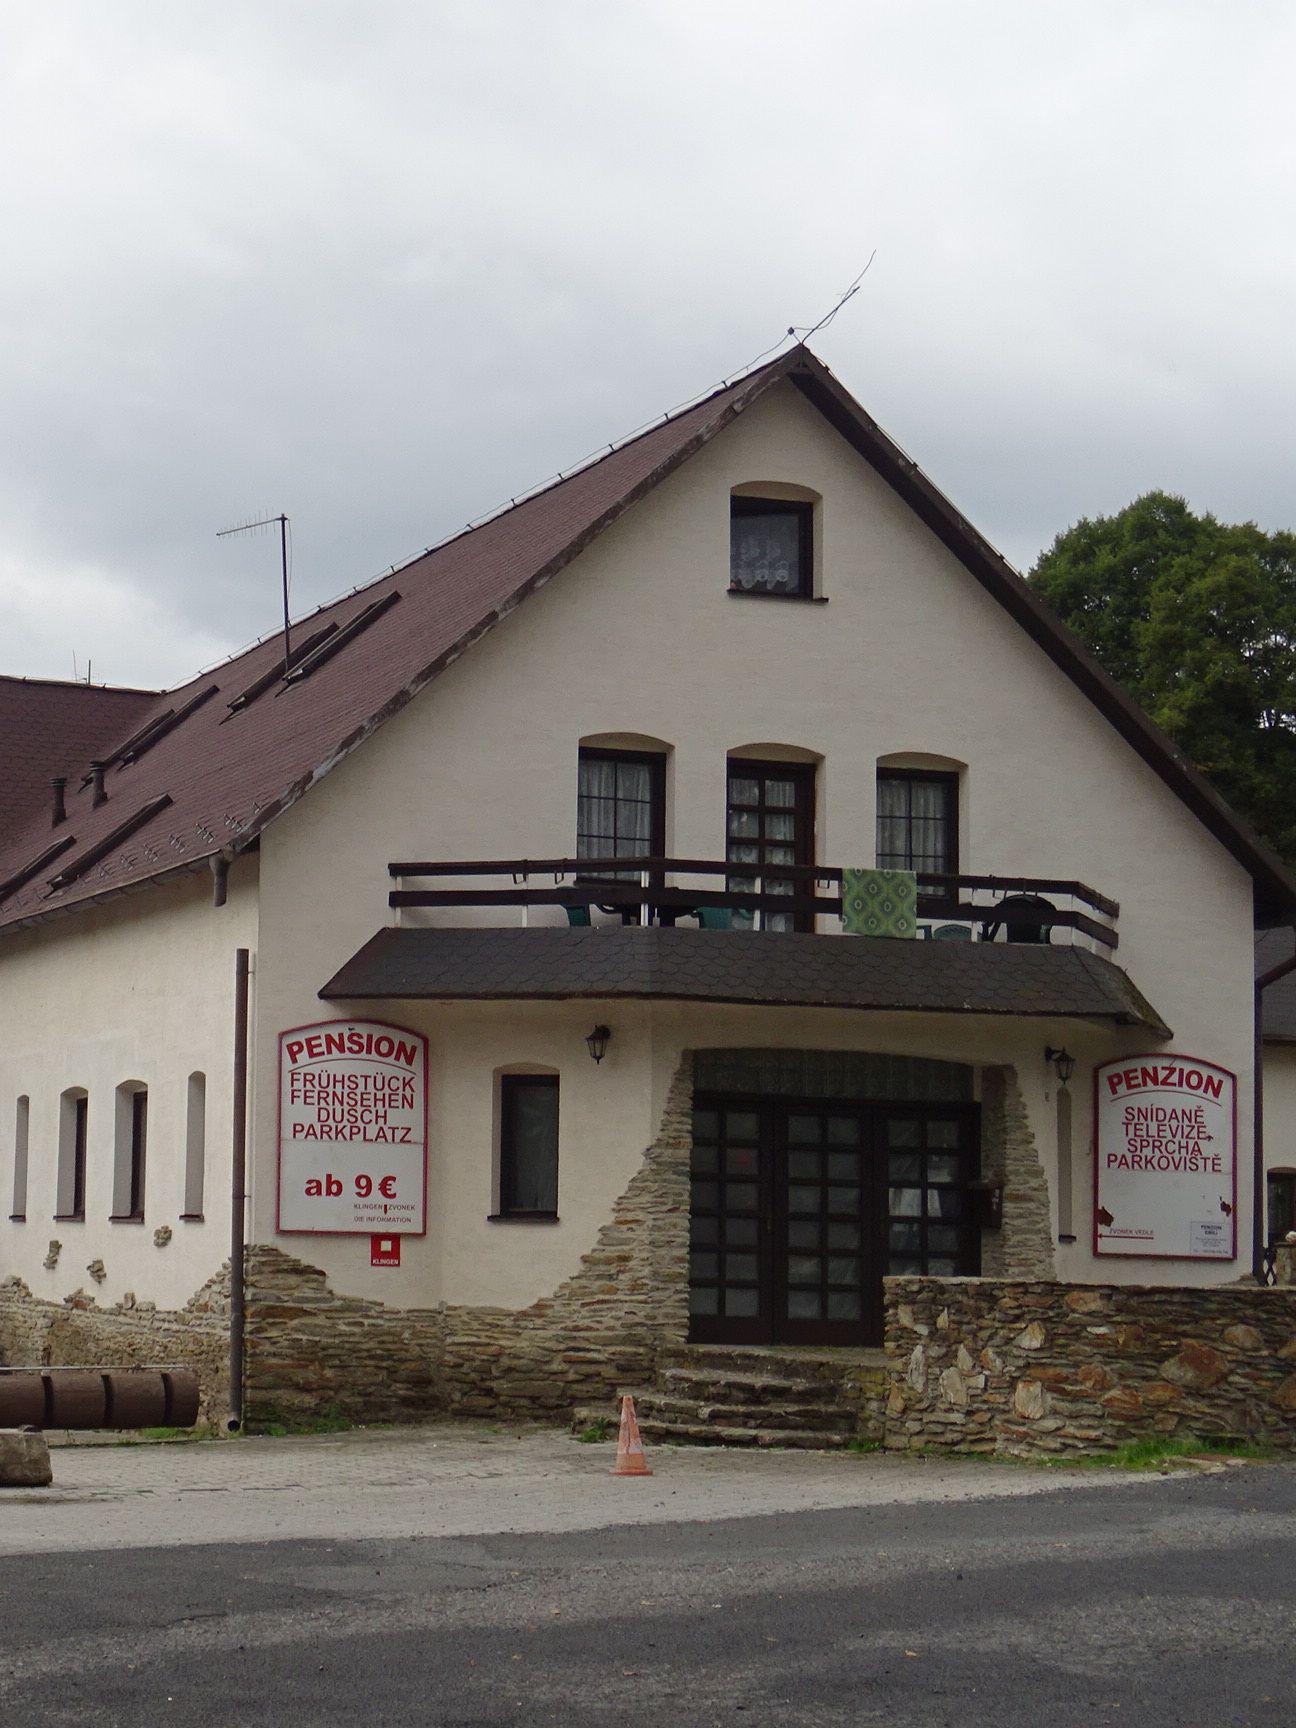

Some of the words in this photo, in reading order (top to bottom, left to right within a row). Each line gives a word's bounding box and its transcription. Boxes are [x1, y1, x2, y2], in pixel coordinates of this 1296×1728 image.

[286, 1032, 417, 1067] PENSION
[290, 1069, 415, 1093] FRÜHSTÜCK
[1106, 1066, 1224, 1099] PENZION
[290, 1089, 414, 1110] FERNSEHEN
[317, 1107, 388, 1125] DUSCH
[1124, 1103, 1205, 1124] SNÍDANĚ
[292, 1123, 412, 1144] PARKPLATZ
[1122, 1121, 1207, 1140] TELEVIZE
[1127, 1138, 1202, 1156] SPRCHA
[1107, 1153, 1222, 1173] PARKOVIŠTĚ
[304, 1173, 343, 1198] ab
[354, 1174, 373, 1198] 9
[378, 1175, 397, 1199] €
